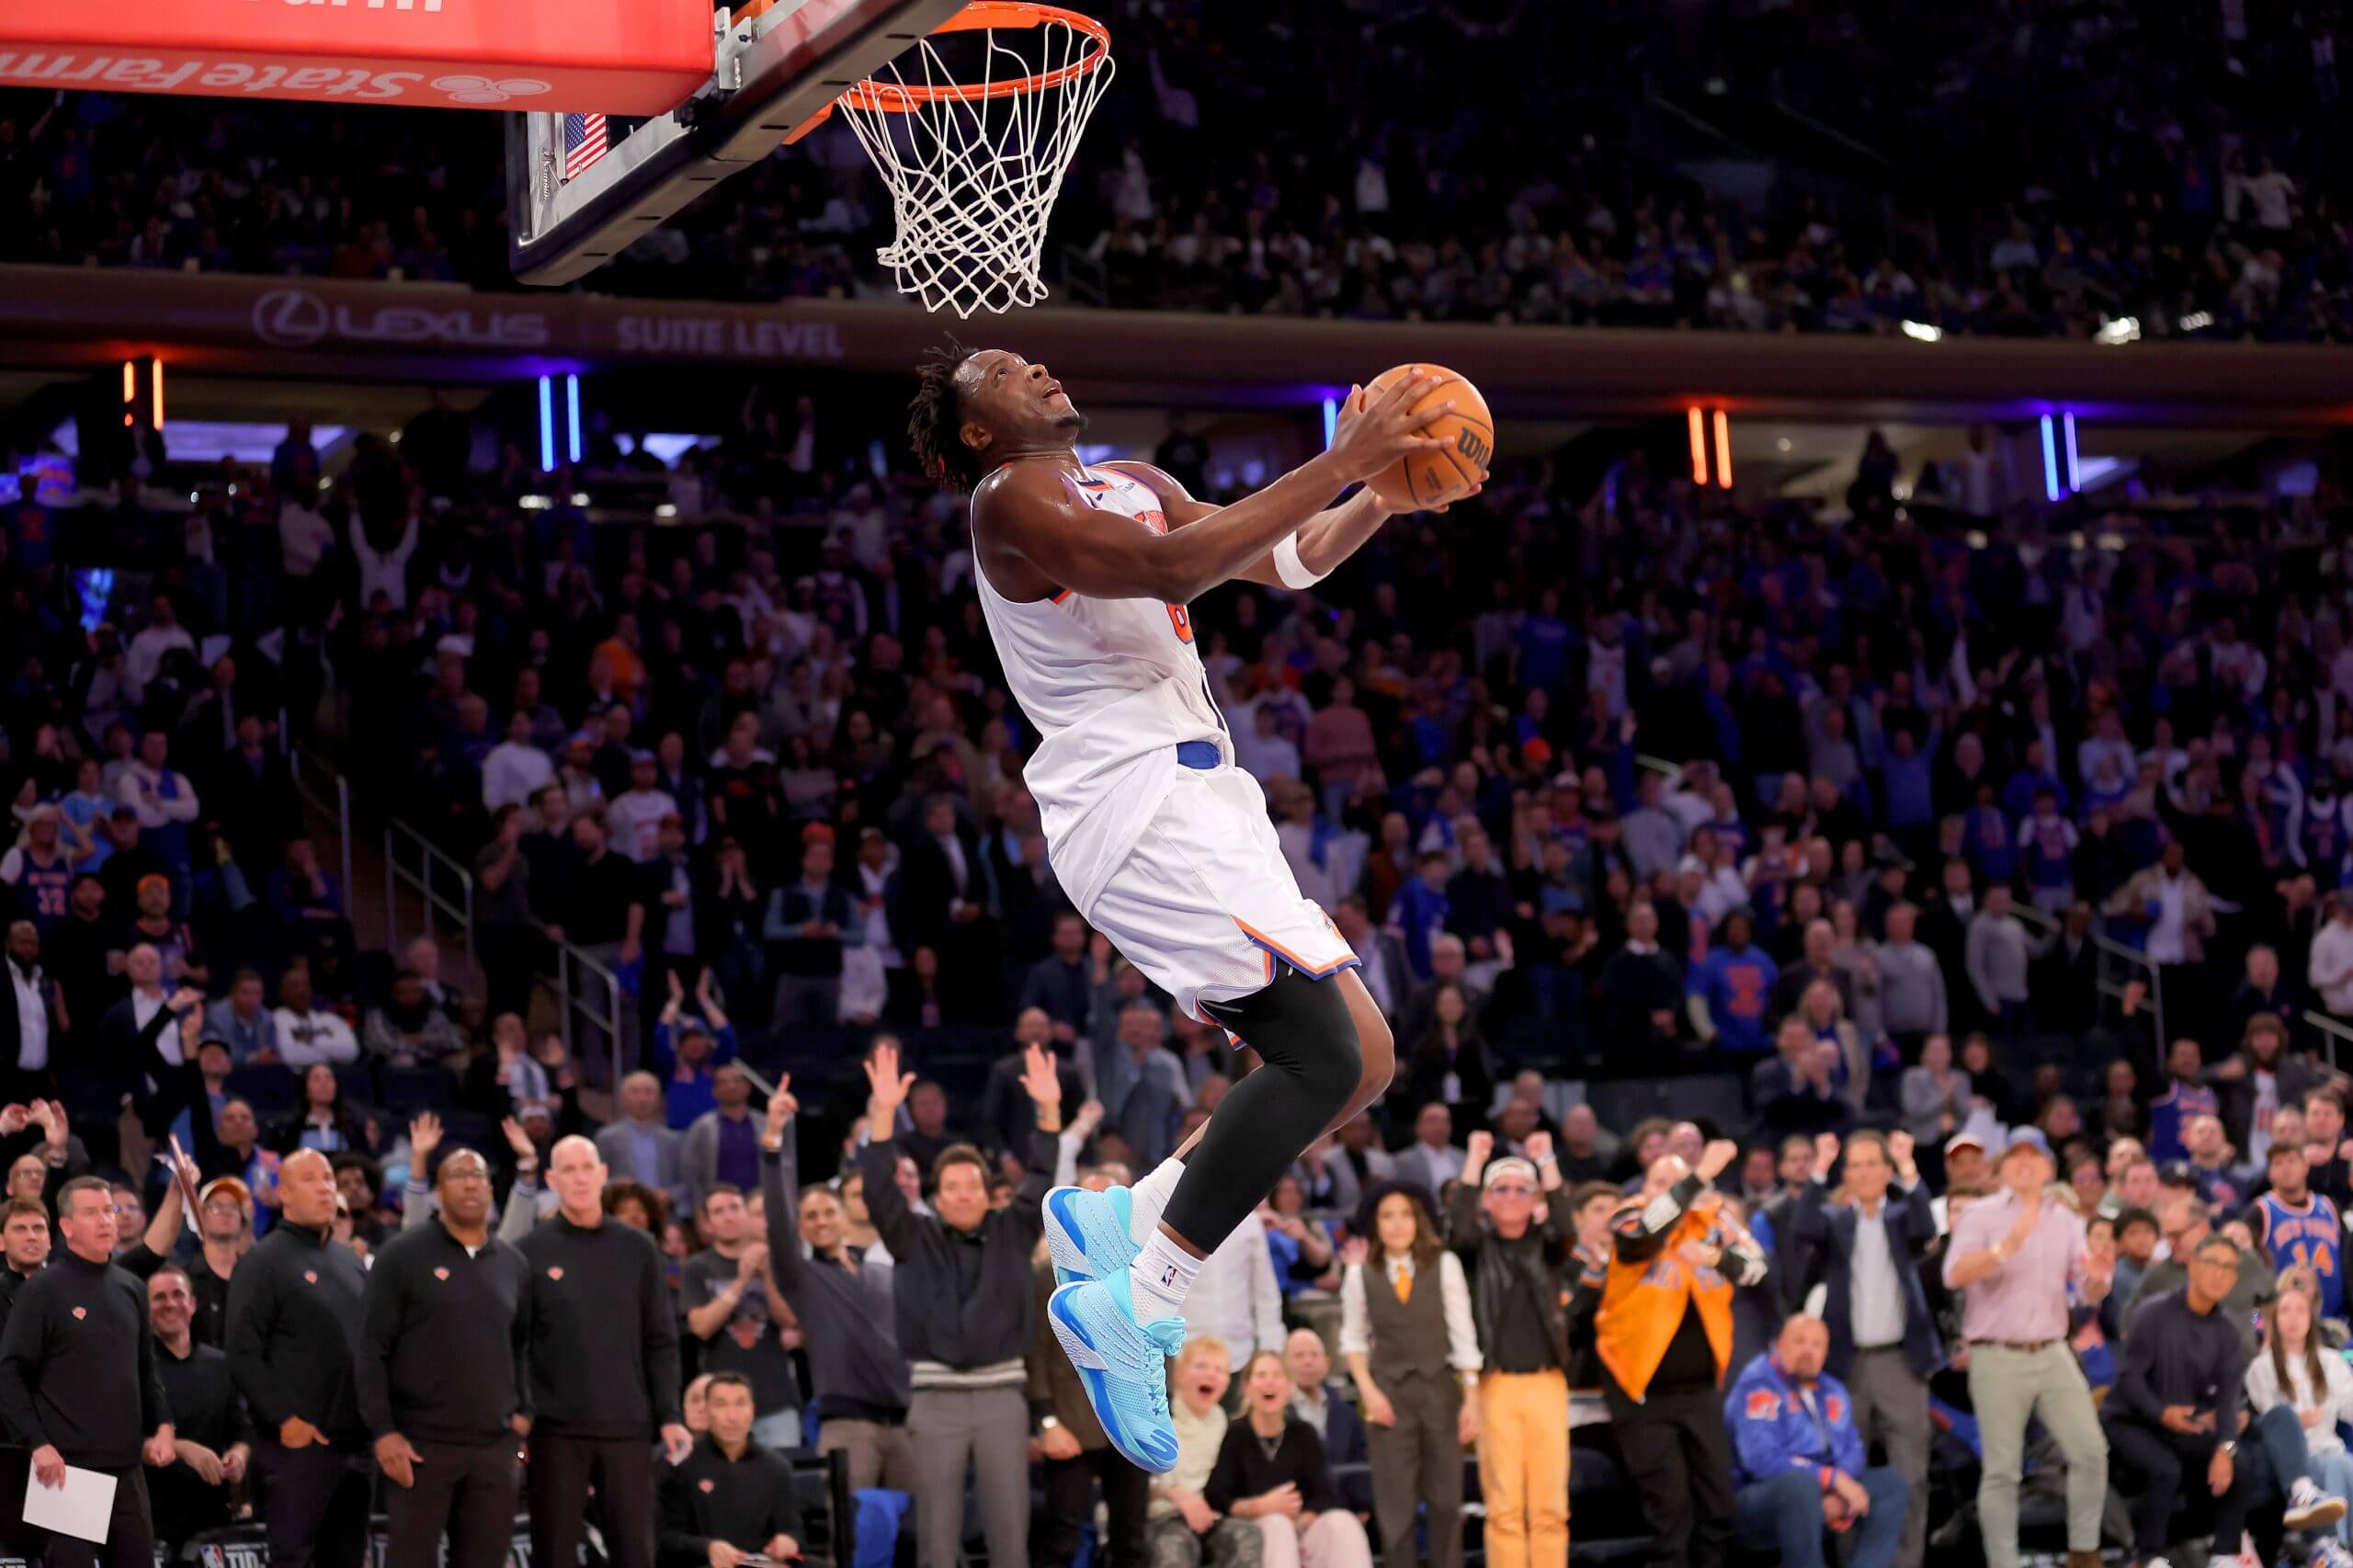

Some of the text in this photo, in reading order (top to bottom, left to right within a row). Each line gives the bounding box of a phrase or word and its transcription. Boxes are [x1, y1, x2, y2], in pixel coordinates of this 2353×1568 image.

[335, 305, 550, 347] LEXUS
[618, 316, 845, 358] SUITE LEVEL
